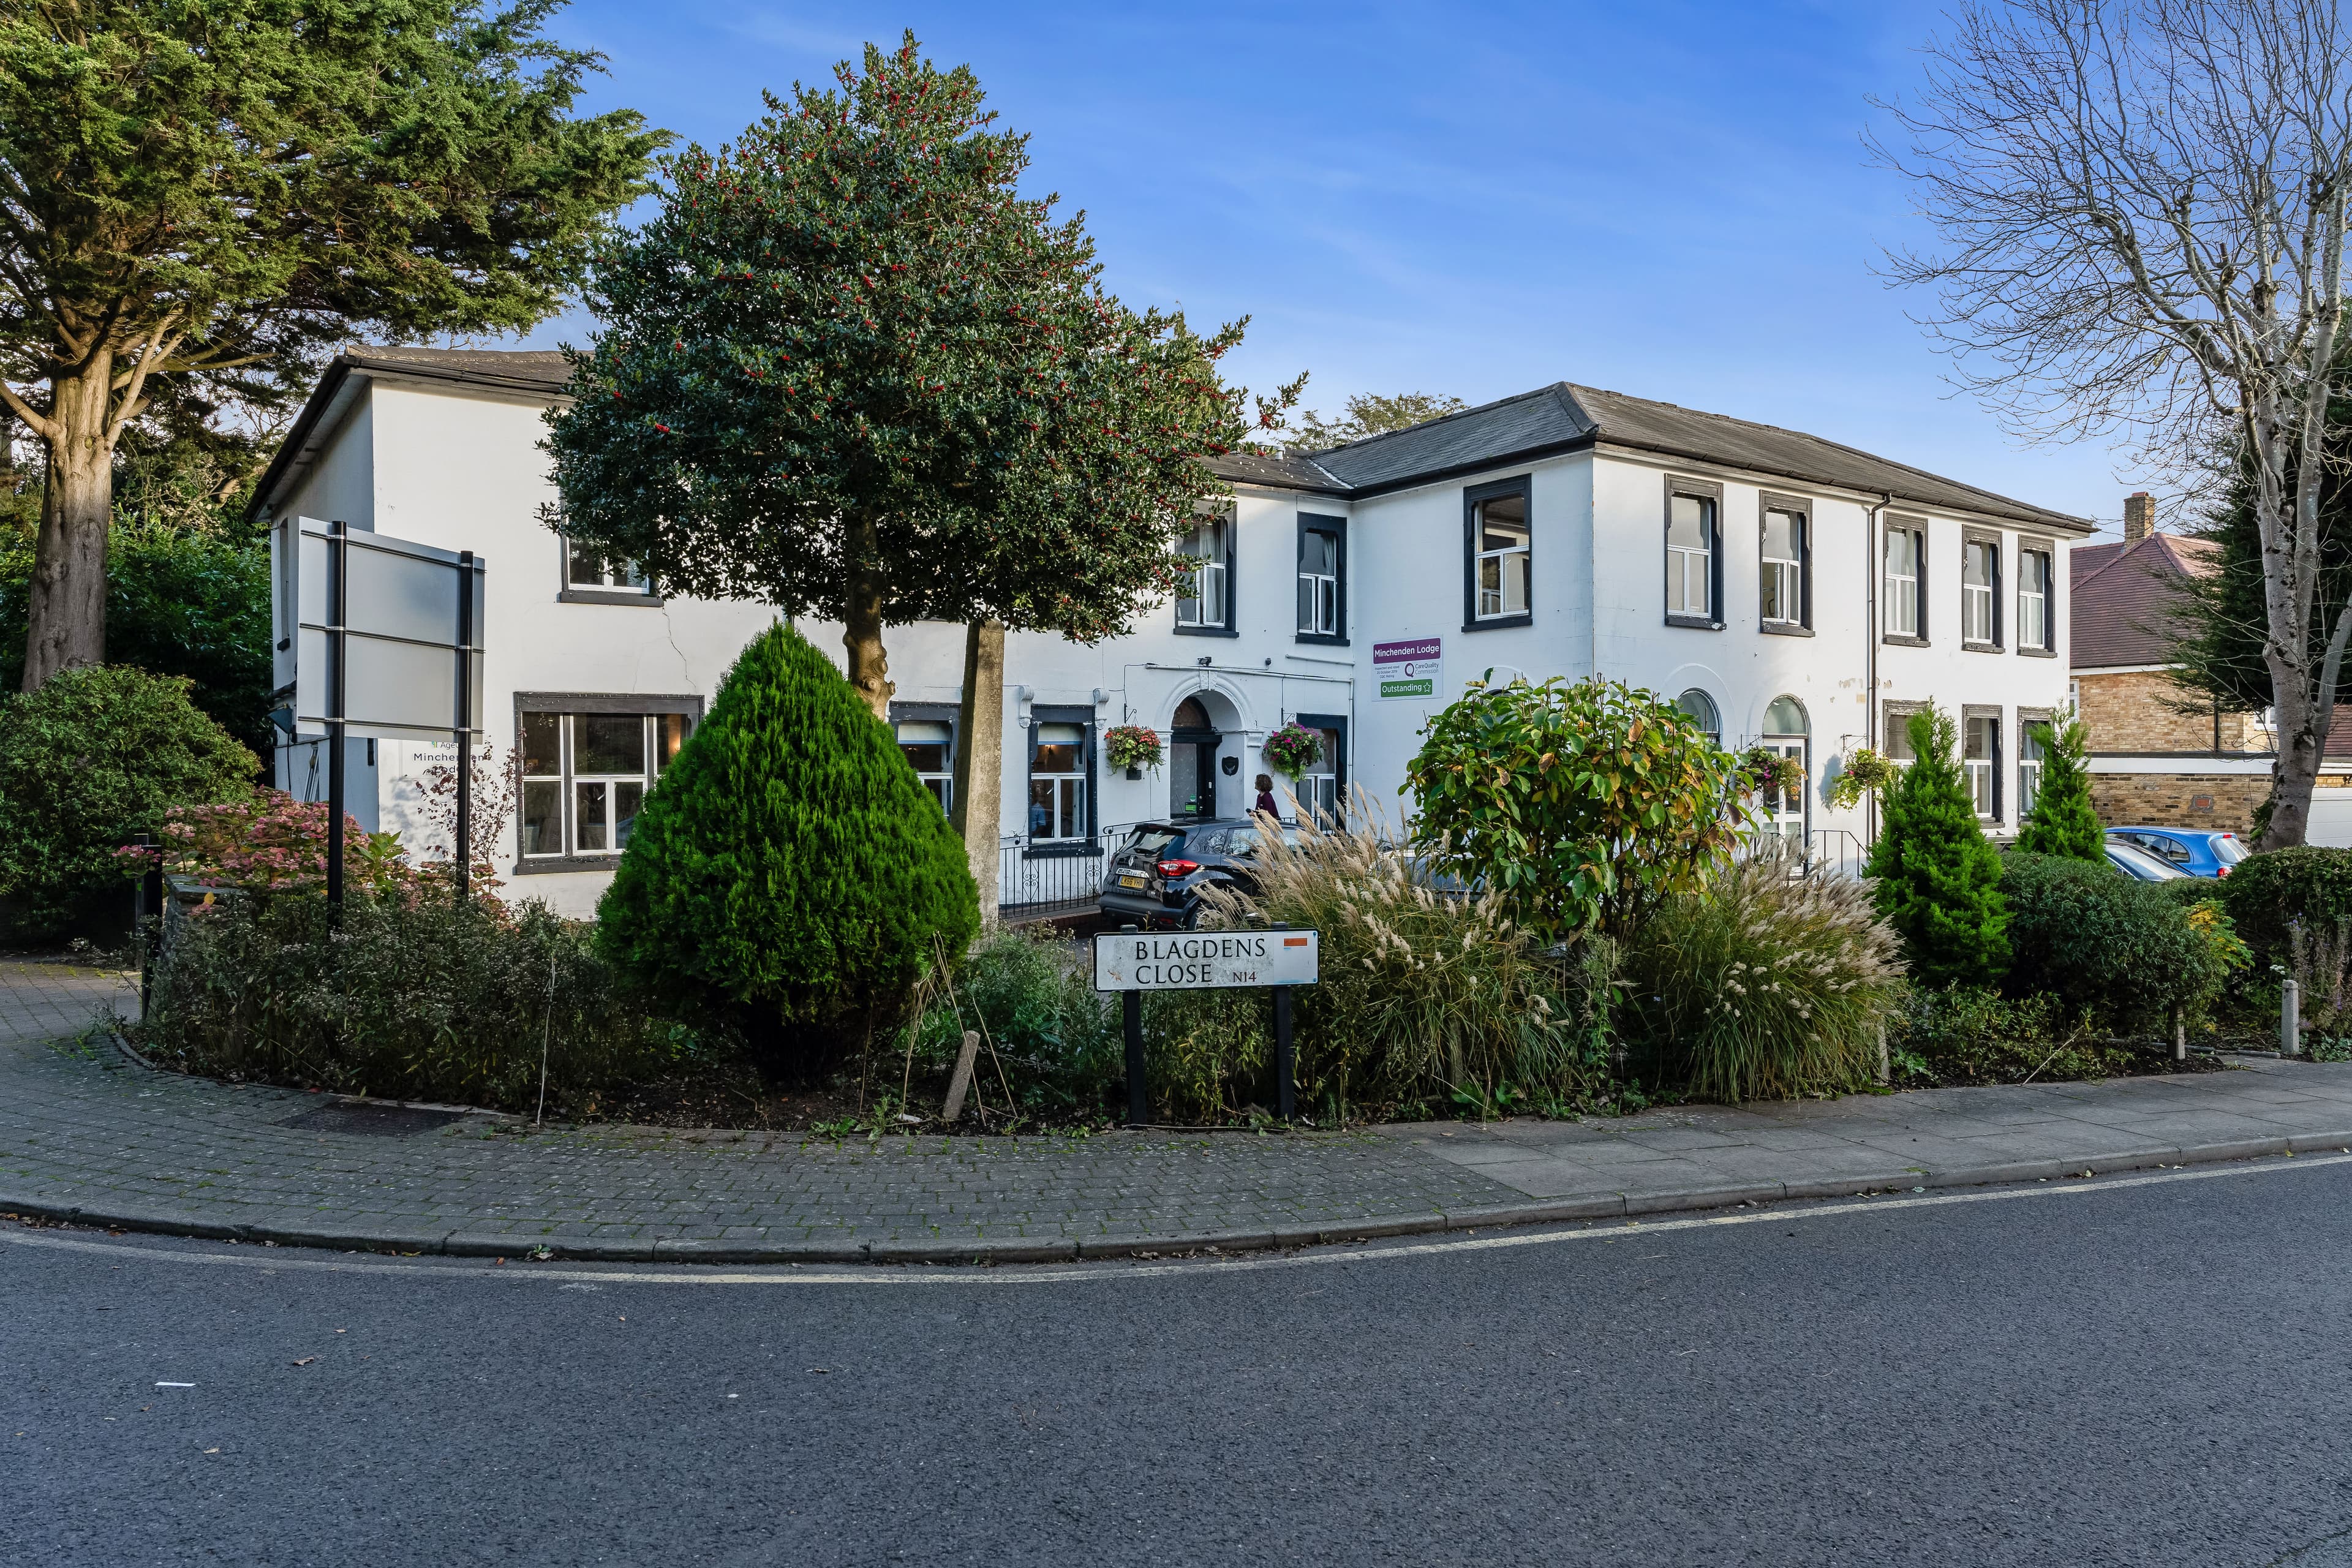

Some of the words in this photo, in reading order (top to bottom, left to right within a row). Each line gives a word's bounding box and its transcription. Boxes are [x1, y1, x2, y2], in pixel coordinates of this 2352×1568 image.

[1374, 647, 1415, 657] Minchenden
[1417, 644, 1439, 654] Lodge
[1382, 684, 1422, 693] Outstanding
[1136, 938, 1265, 960] BLAGDENS
[1136, 964, 1212, 984] CLOSE
[1233, 971, 1257, 983] N14
